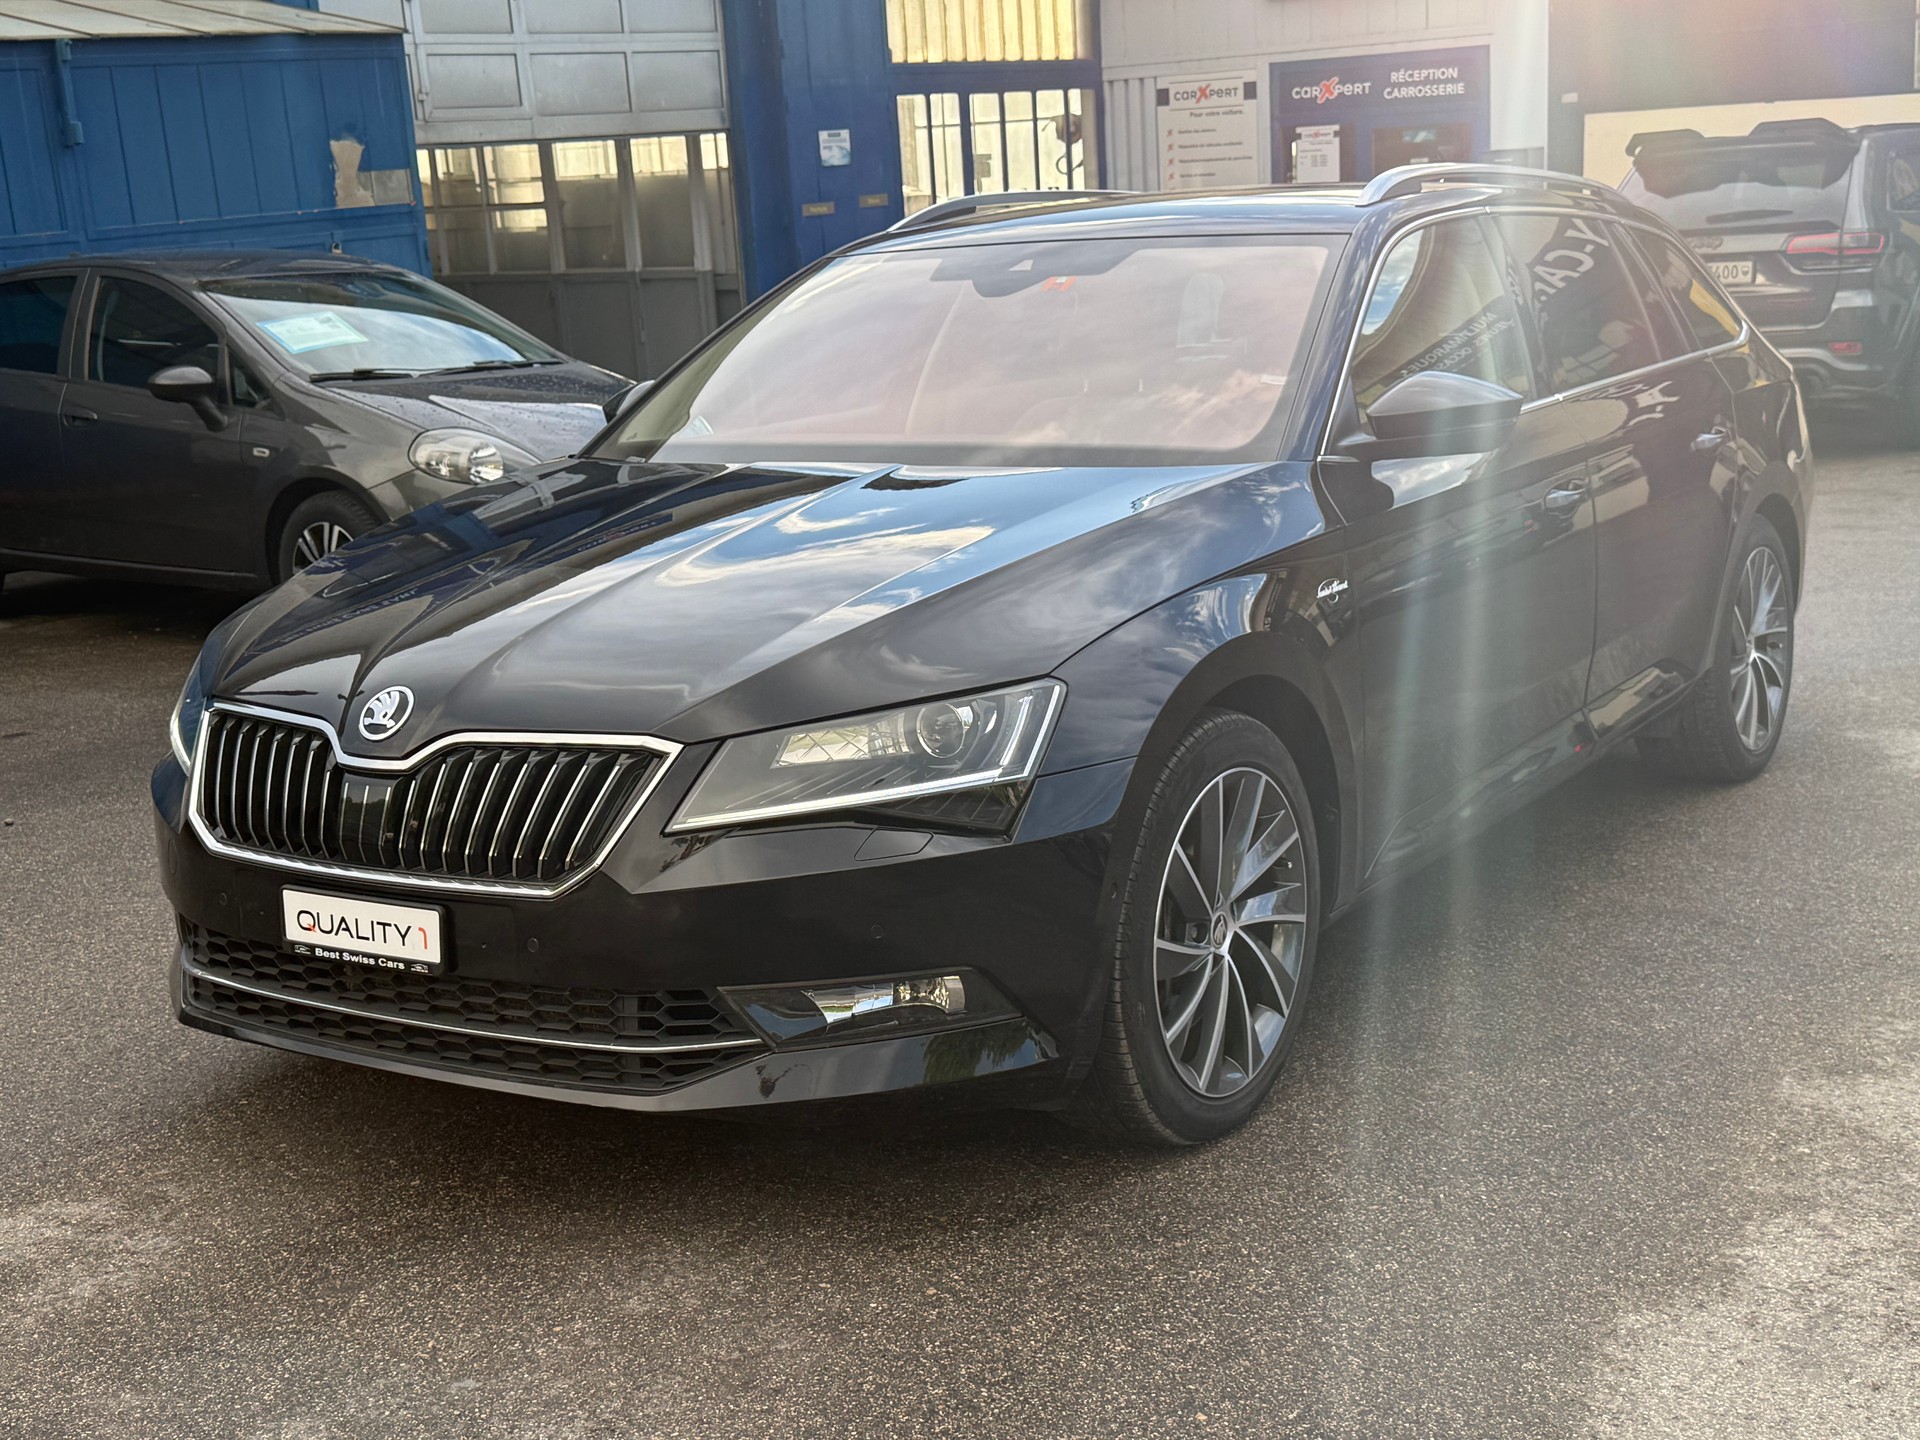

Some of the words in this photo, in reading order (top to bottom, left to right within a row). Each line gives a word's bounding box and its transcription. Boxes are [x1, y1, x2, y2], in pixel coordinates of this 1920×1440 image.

[1390, 67, 1458, 83] RÉCEPTION
[1383, 82, 1465, 100] CARROSSERIE
[1708, 264, 1739, 280] 400
[297, 910, 412, 946] QUALITY
[418, 926, 428, 950] 1
[314, 947, 340, 960] Best
[342, 951, 376, 966] Swiss
[378, 958, 405, 970] Cars
